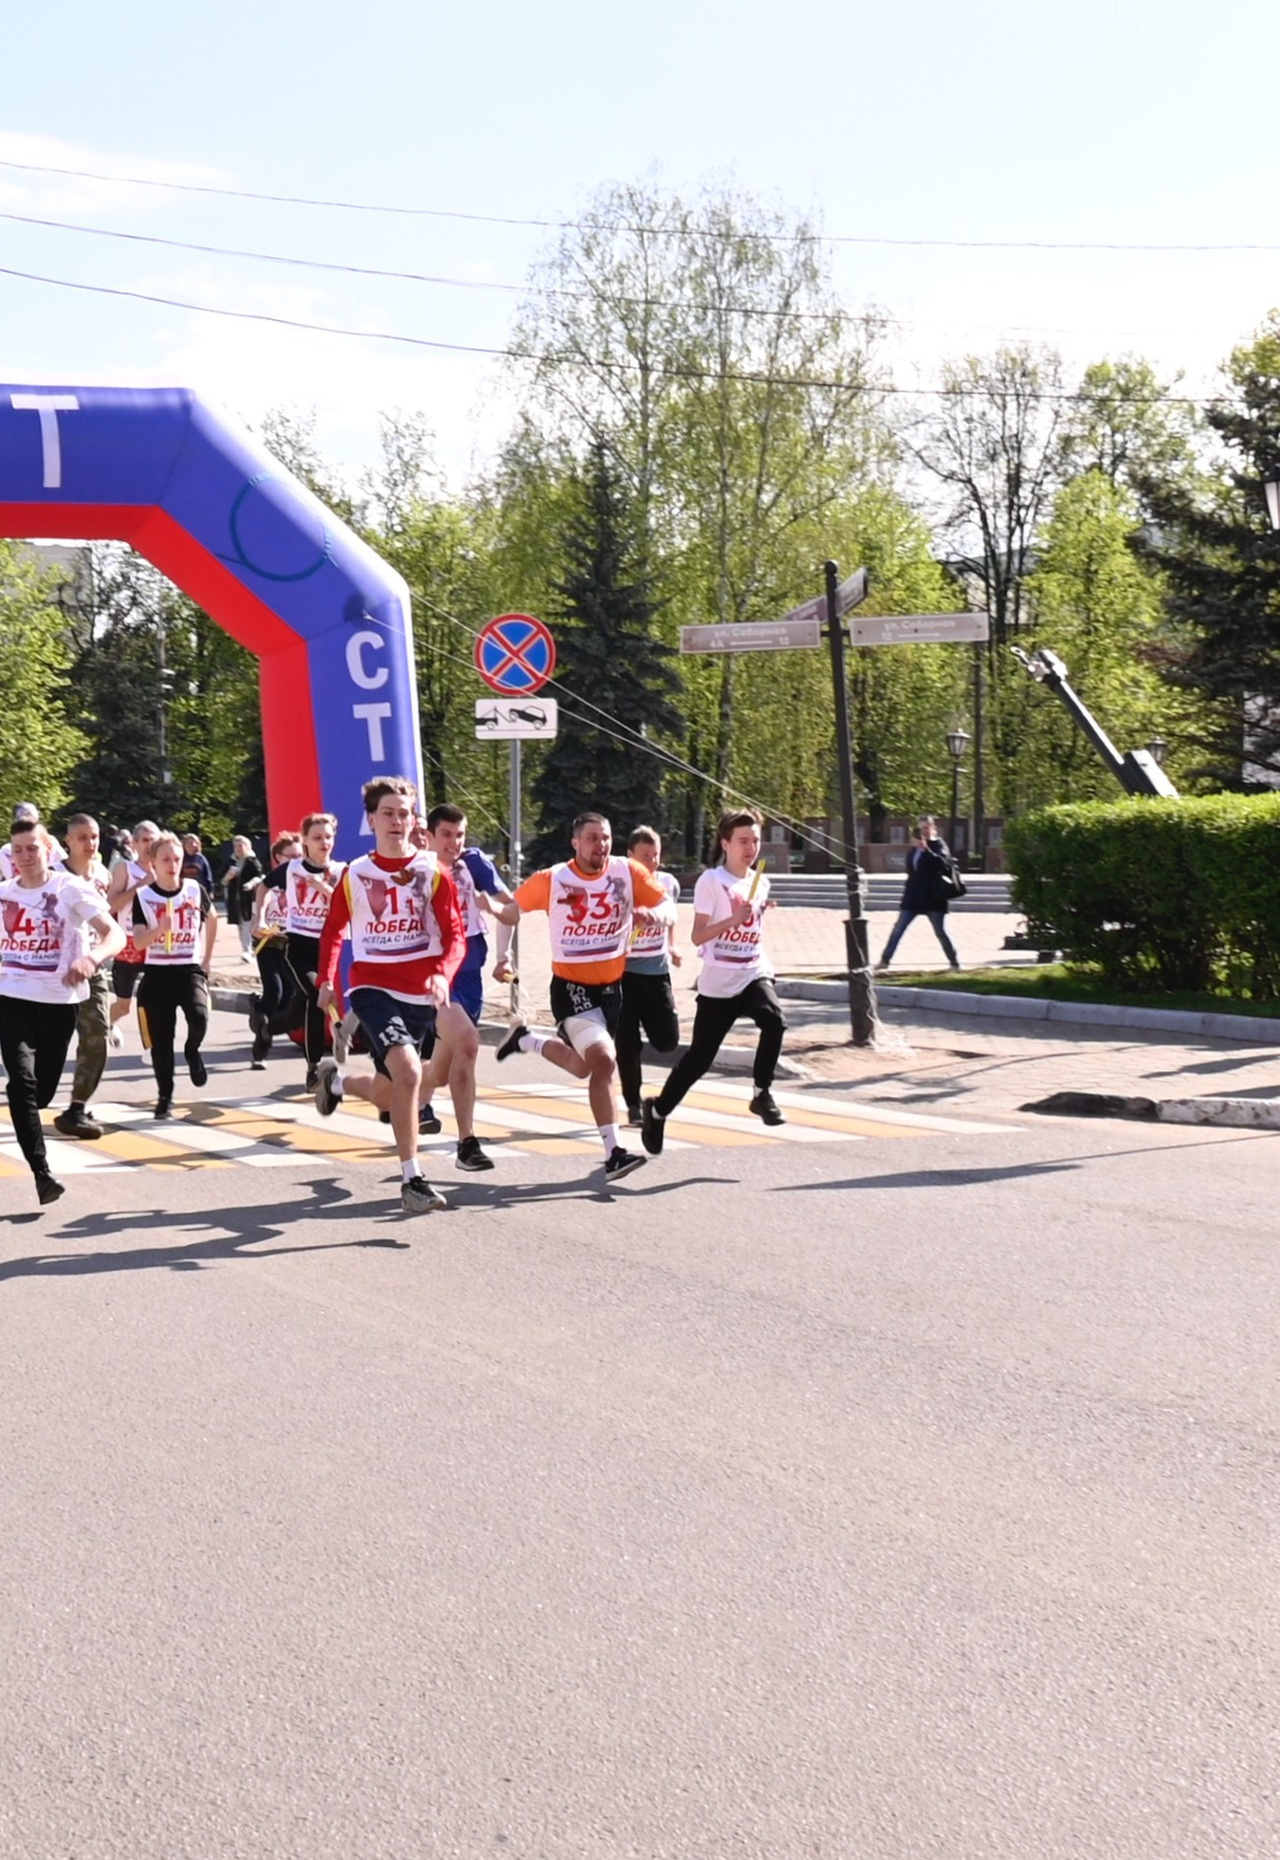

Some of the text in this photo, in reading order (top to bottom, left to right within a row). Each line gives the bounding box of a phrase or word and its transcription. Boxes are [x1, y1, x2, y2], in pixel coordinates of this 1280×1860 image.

[732, 626, 787, 638] Соборная
[345, 630, 393, 836] СТ
[0, 938, 60, 954] ПОБЕДА
